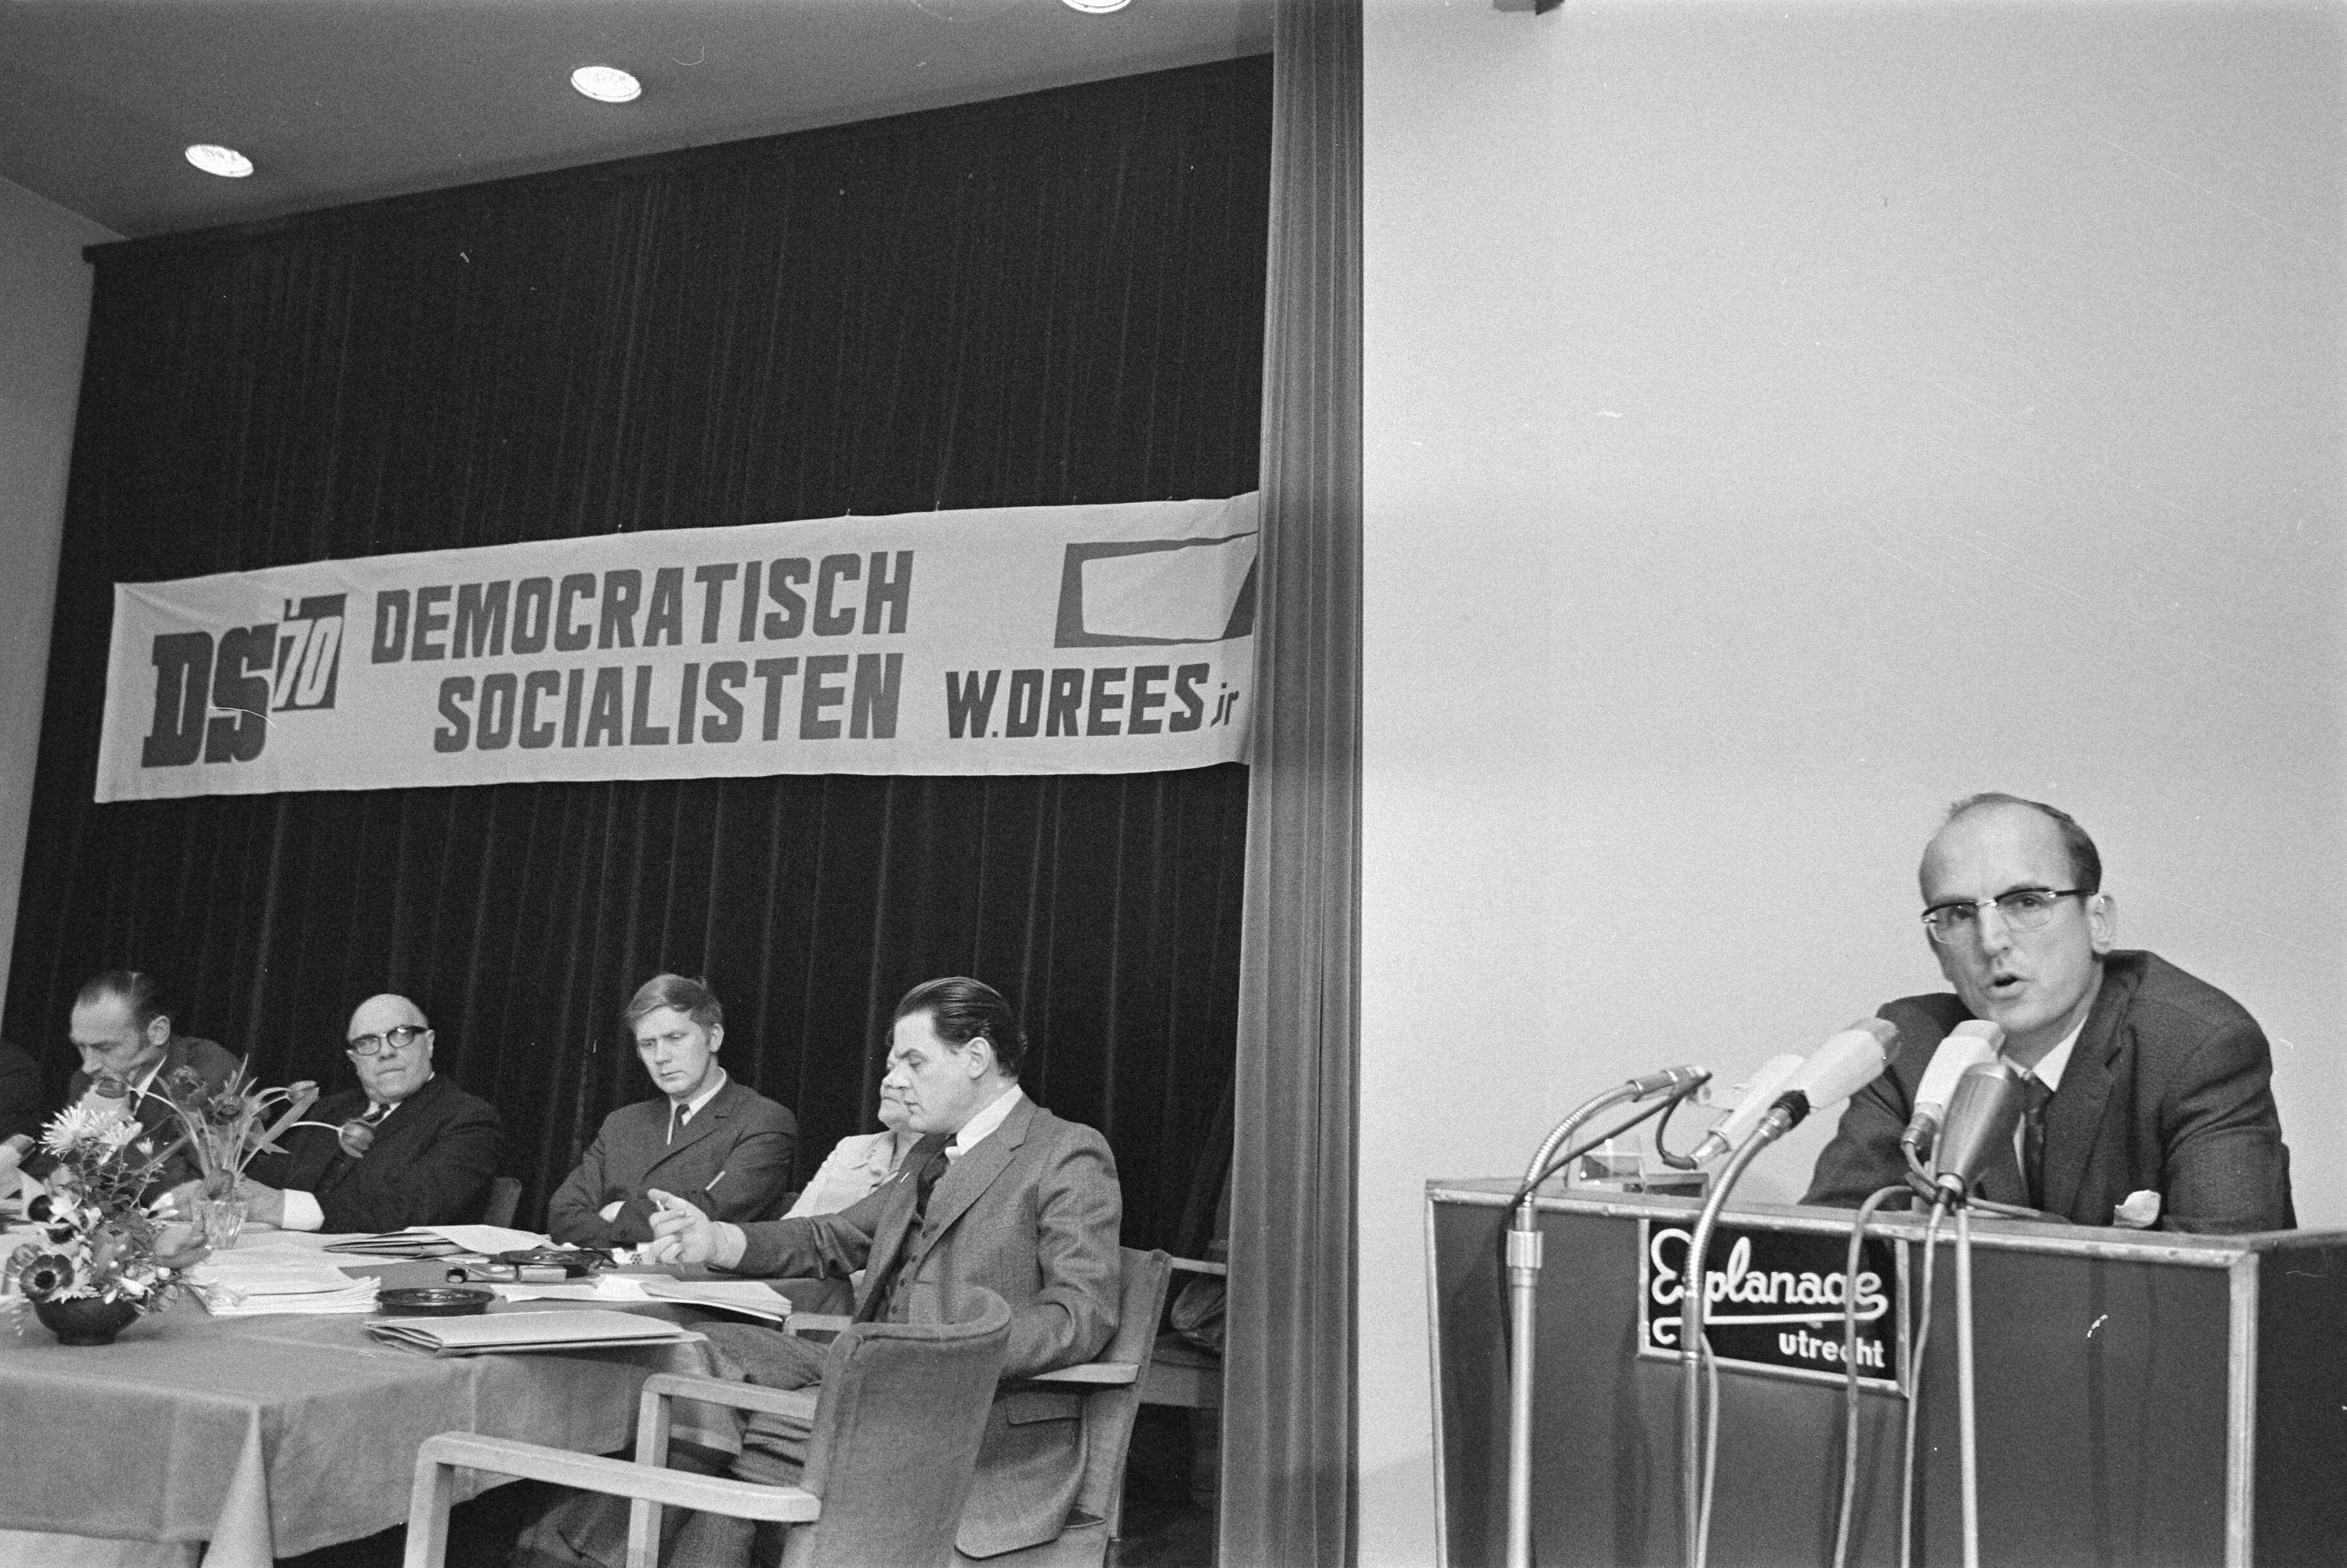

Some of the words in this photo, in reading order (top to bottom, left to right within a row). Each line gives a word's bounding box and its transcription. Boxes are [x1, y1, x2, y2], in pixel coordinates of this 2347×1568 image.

[372, 551, 915, 664] DEMOCRATISCH
[433, 652, 904, 752] SOCIALISTEN
[1210, 681, 1239, 728] jr
[1650, 1228, 1889, 1325] Eplanade
